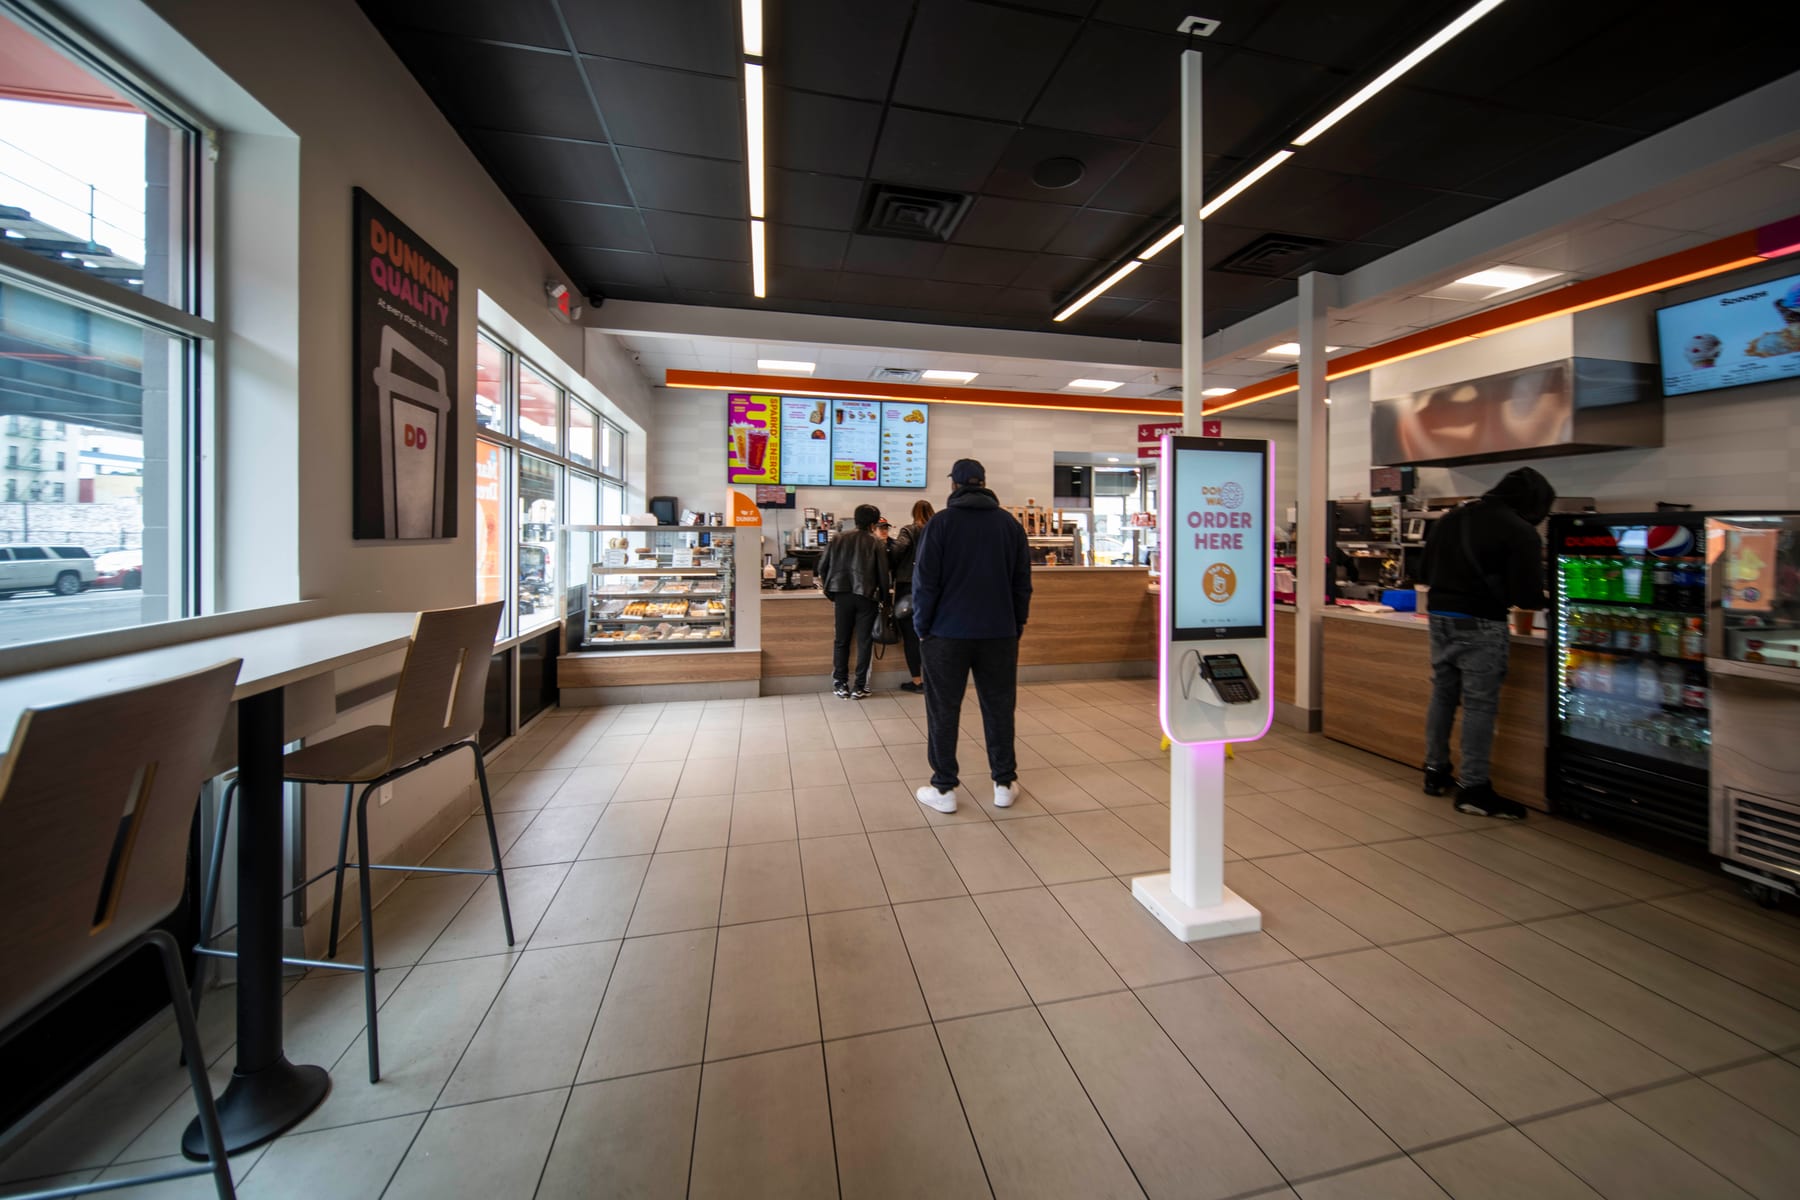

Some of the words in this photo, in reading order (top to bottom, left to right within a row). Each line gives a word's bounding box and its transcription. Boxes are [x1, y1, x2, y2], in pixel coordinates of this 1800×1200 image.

[370, 218, 453, 303] DUNKIN'
[370, 256, 449, 327] QUALITY
[404, 423, 427, 450] DD
[769, 442, 778, 482] ENERGY
[1187, 511, 1252, 529] ORDER
[1194, 533, 1244, 550] HERE
